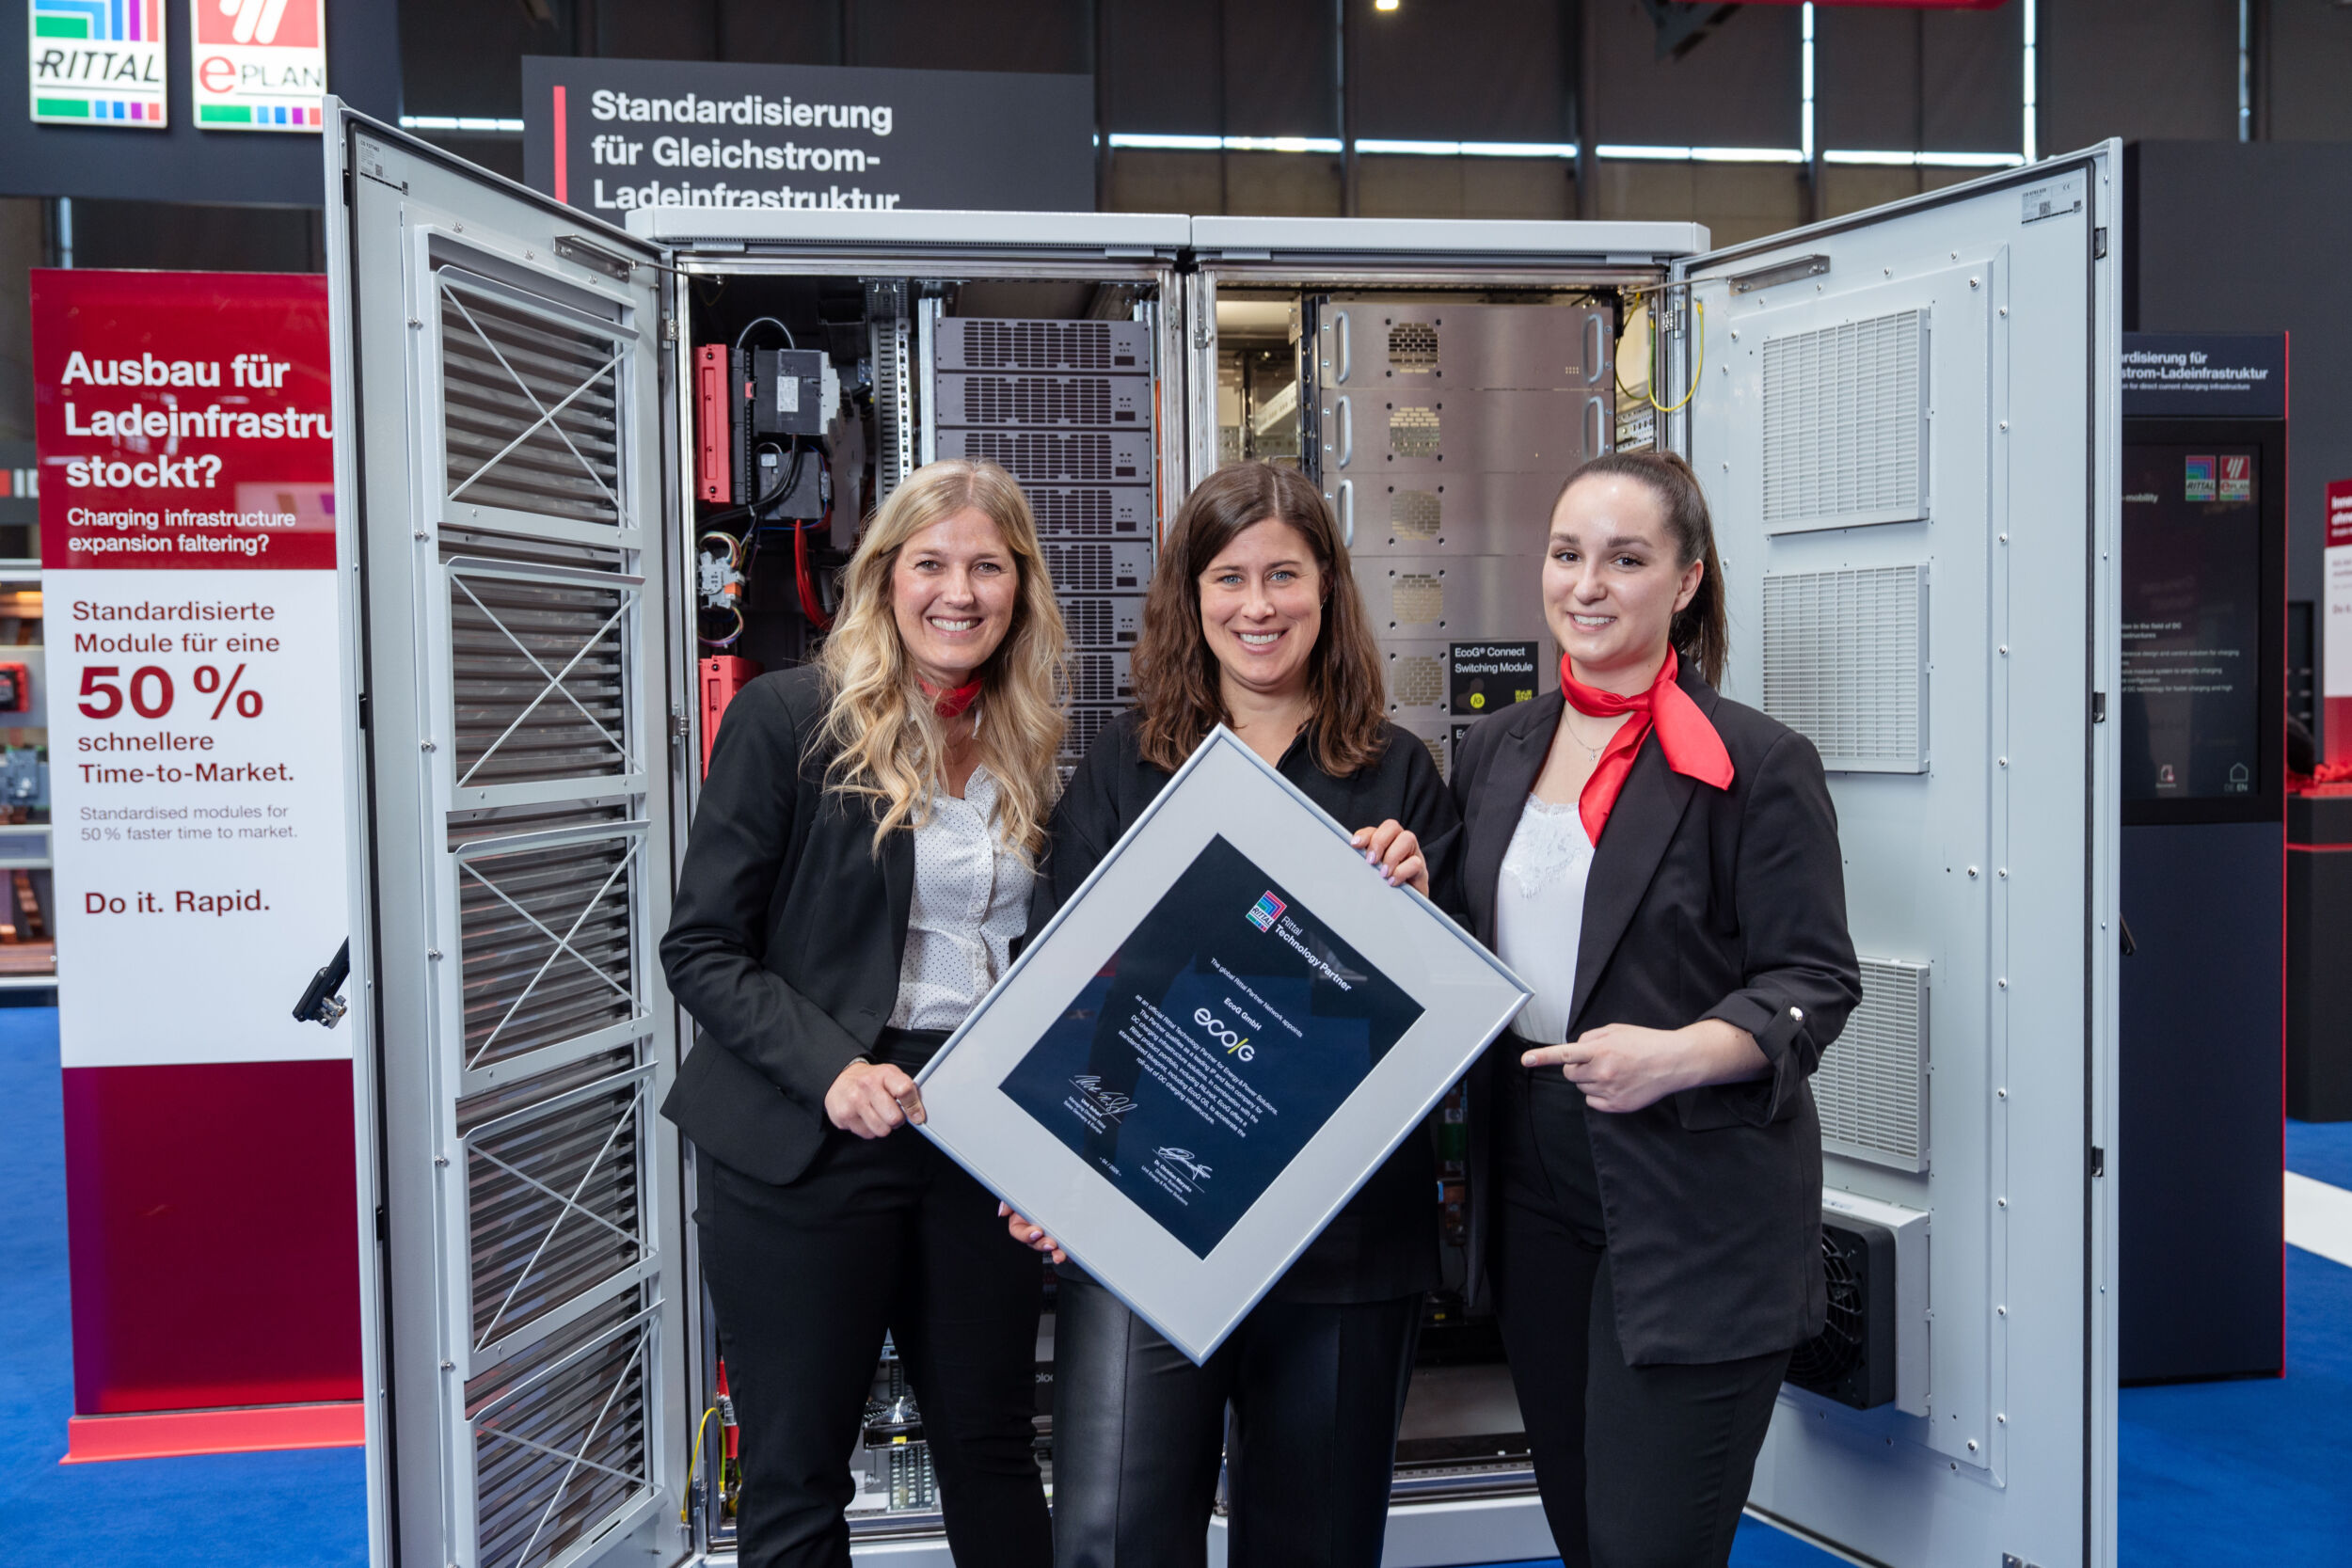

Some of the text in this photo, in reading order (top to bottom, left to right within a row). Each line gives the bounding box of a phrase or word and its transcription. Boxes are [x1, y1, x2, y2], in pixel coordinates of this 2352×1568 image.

[36, 49, 161, 83] RITTAL
[591, 89, 893, 136] Standardisierung
[591, 135, 881, 171] für Gleichstrom-
[594, 180, 899, 210] Ladeinfrastruktur
[60, 351, 290, 388] Ausbau für
[2189, 351, 2208, 364] für
[66, 454, 222, 488] stockt?
[67, 507, 295, 530] Charging infrastructure
[68, 533, 269, 556] expansion faltering?
[72, 600, 275, 621] Standardisierte
[74, 633, 280, 653] Module für eine
[1486, 647, 1525, 657] Connect
[1454, 662, 1534, 674] Switching Module
[77, 663, 263, 720] 50 %
[77, 732, 214, 752] schnellere
[79, 762, 294, 783] Time-to-Market.
[80, 804, 288, 820] Standardised modules for
[127, 826, 171, 840] faster
[177, 826, 212, 839] time
[217, 827, 232, 839] to
[238, 825, 297, 838] market.
[85, 889, 270, 916] Do it. Rapid.
[1251, 907, 1274, 927] RITTAL
[1281, 915, 1302, 935] Rittal
[1275, 924, 1351, 990] Technology Partner
[1211, 958, 1302, 1037] The global Rittal Partner Network appoints
[1224, 997, 1262, 1030] EcoG GmbH
[1138, 1022, 1158, 1040] charging
[1158, 1037, 1187, 1063] infrastructure
[1213, 1085, 1240, 1108] combination
[1240, 1106, 1250, 1117] with
[1249, 1114, 1258, 1123] the
[1139, 1008, 1149, 1019] The
[1148, 1017, 1166, 1032] Partner
[1165, 1031, 1184, 1048] qualifies
[1193, 1053, 1210, 1070] leading
[1215, 1073, 1225, 1083] and
[1224, 1080, 1234, 1091] tech
[1234, 1089, 1255, 1108] company
[1148, 1005, 1164, 1019] official
[1162, 1016, 1176, 1029] Rittal
[1175, 1026, 1200, 1050] Technology
[1200, 1047, 1216, 1063] Partner
[1223, 1067, 1239, 1083] Energy
[1241, 1082, 1257, 1096] Power
[1256, 1094, 1277, 1115] Solutions.
[1118, 1029, 1148, 1055] standardized
[1168, 1070, 1187, 1089] including
[1187, 1086, 1200, 1100] EcoG
[1214, 1110, 1237, 1131] accelerate
[1237, 1128, 1246, 1137] the
[1129, 1025, 1142, 1038] Rittal
[1140, 1037, 1160, 1053] product
[1179, 1068, 1199, 1086] including
[1216, 1099, 1231, 1112] EcoG
[1230, 1110, 1243, 1123] offers
[1136, 1057, 1153, 1072] roll-out
[1166, 1082, 1185, 1100] charging
[1184, 1097, 1214, 1124] infrastructure.
